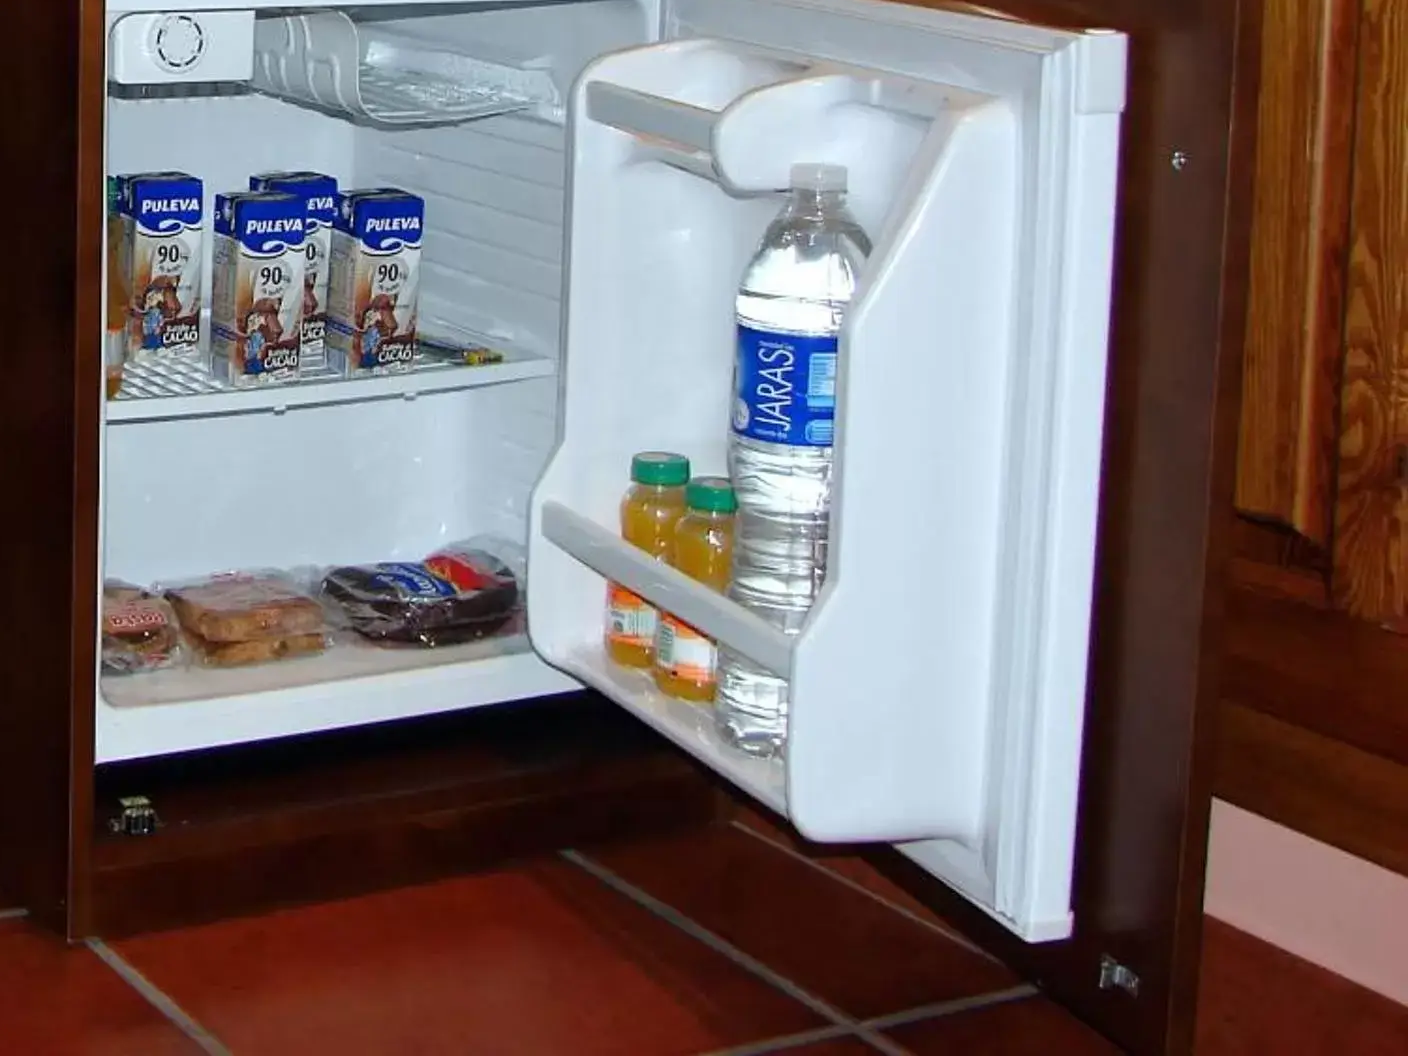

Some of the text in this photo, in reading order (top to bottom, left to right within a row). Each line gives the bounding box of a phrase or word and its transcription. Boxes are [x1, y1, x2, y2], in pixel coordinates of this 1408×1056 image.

[142, 197, 200, 215] PULEVA
[307, 196, 334, 210] EVA
[245, 218, 304, 235] PULEVA
[365, 216, 420, 233] PULEVA
[158, 244, 180, 264] 90
[306, 243, 316, 261] 0
[260, 266, 282, 286] 90
[378, 263, 399, 283] 90
[163, 330, 198, 344] CACAO
[753, 348, 795, 432] JARAS
